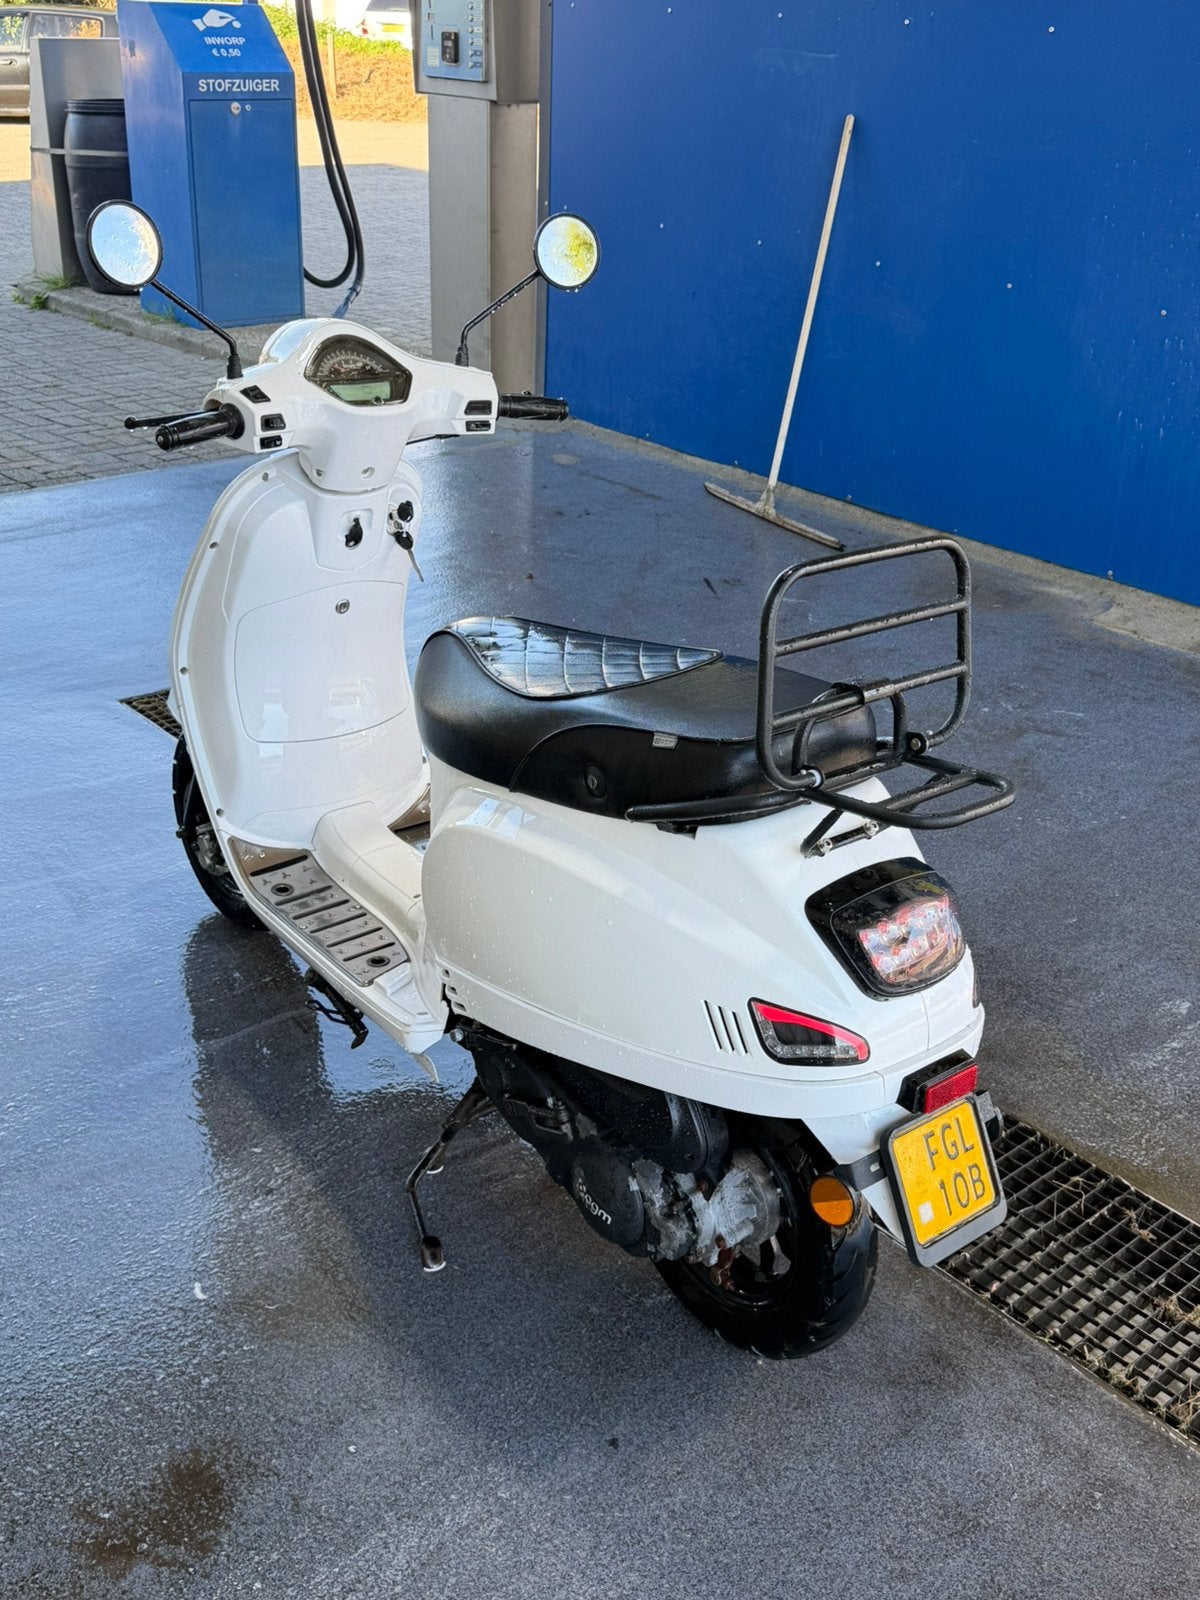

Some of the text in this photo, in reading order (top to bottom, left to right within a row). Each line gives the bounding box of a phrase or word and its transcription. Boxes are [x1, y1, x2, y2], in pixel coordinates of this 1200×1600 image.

[205, 36, 246, 50] INWORP
[212, 48, 241, 58] € 0,50
[198, 79, 280, 92] STOFZUIGER
[922, 1117, 974, 1171] FGL
[938, 1163, 985, 1216] 10B
